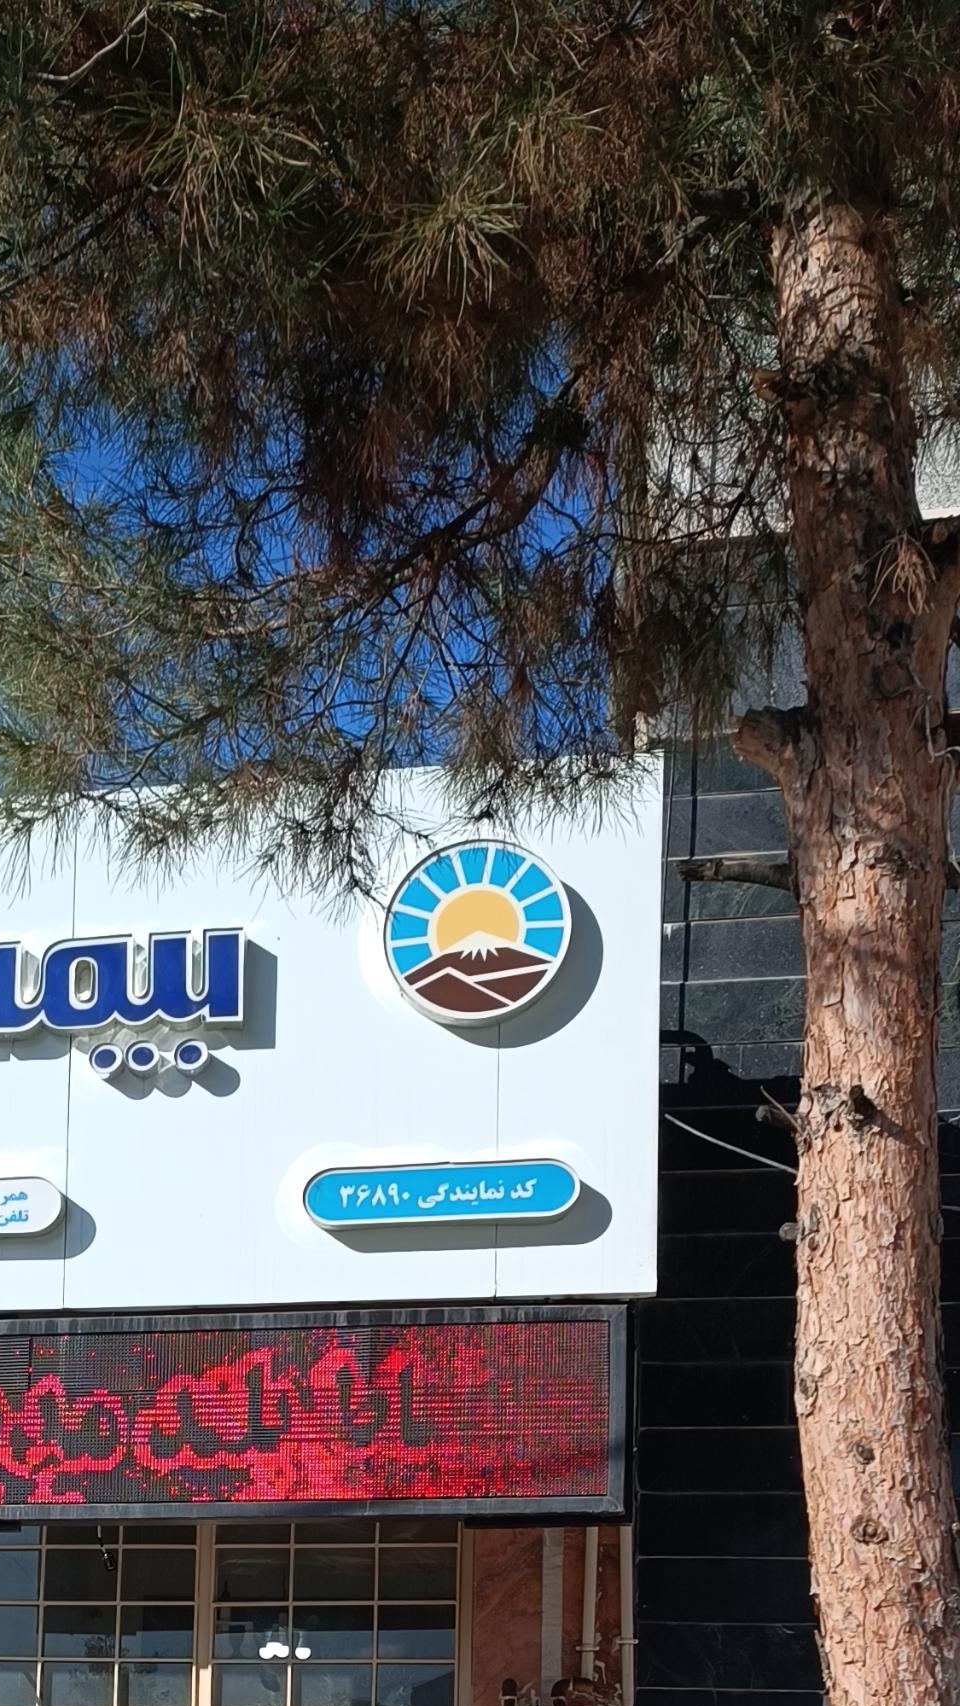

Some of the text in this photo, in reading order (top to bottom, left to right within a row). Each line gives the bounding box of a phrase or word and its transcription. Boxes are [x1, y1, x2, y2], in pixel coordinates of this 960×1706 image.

[339, 1178, 538, 1209] کد نمایندگی ۳۶۸۹۰
